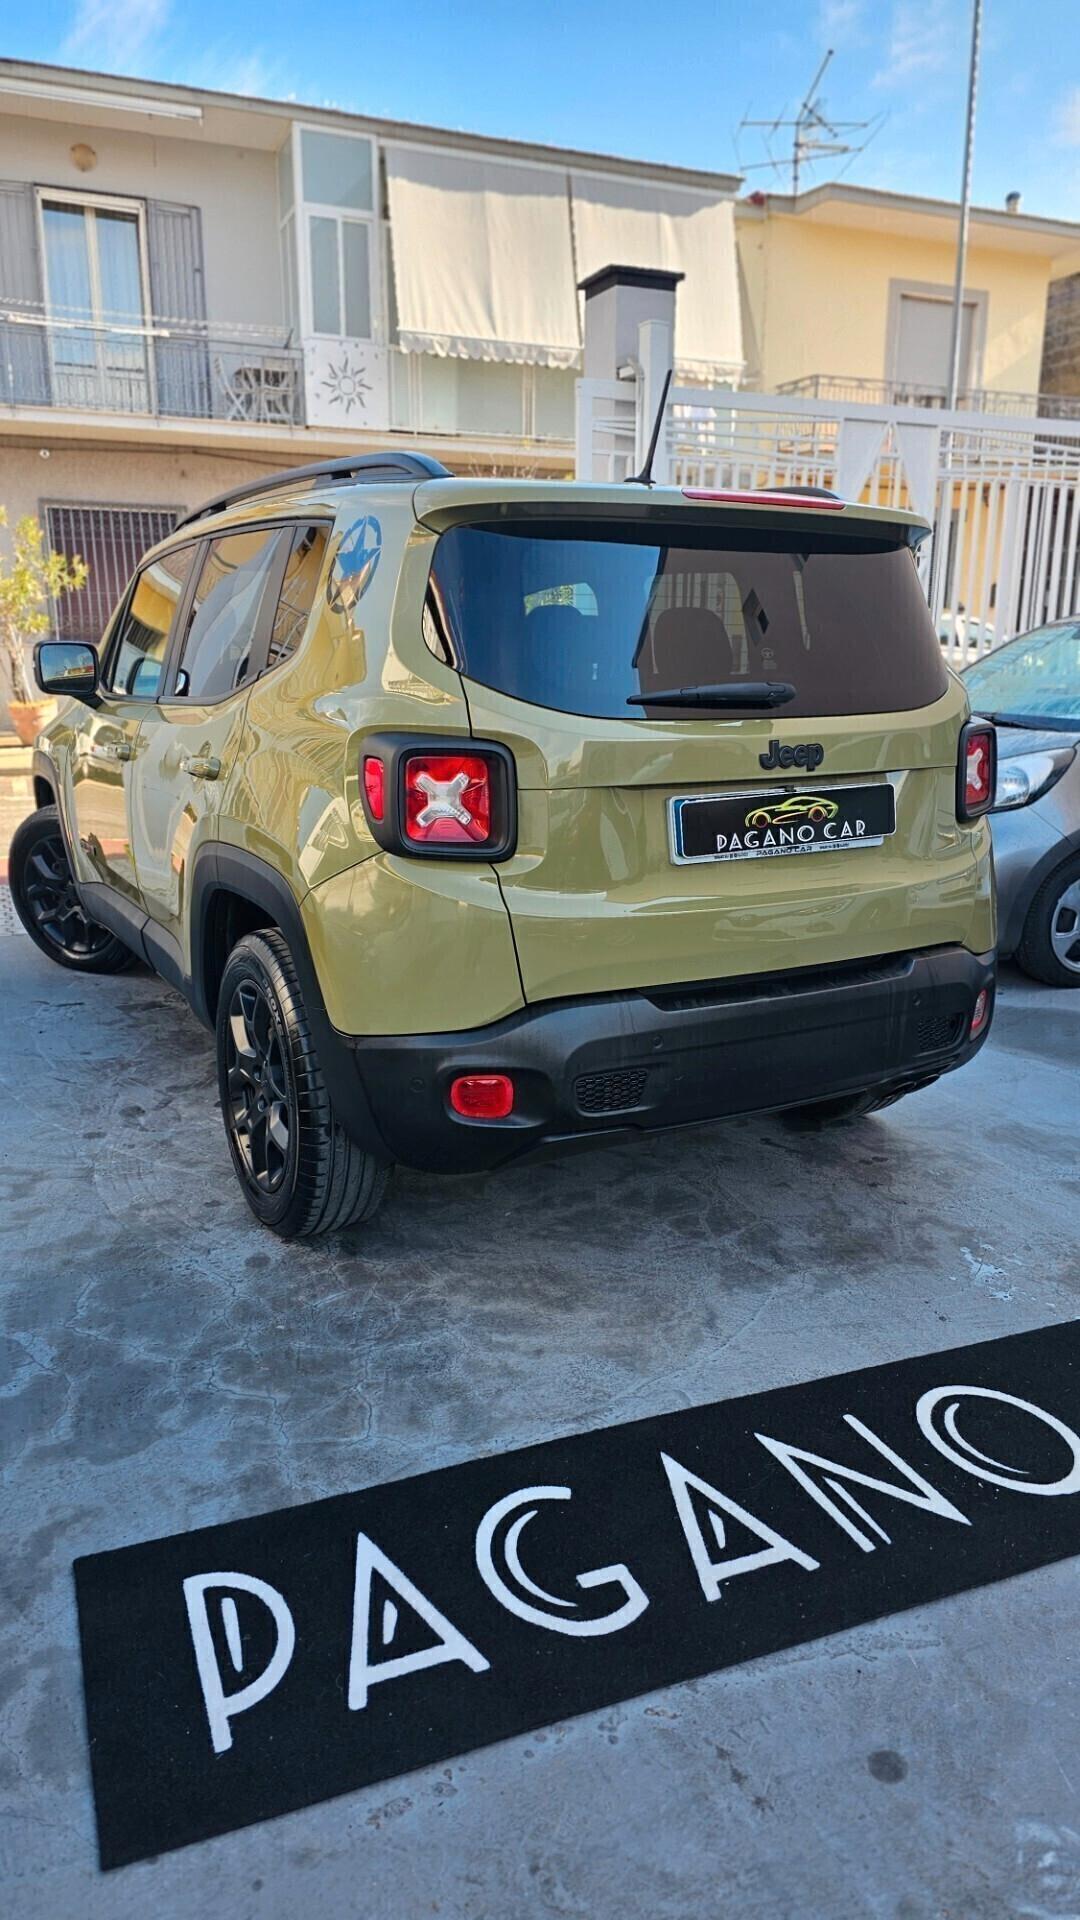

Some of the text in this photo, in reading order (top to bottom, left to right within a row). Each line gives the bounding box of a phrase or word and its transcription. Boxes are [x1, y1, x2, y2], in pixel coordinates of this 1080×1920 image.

[759, 739, 825, 772] Jeep
[716, 819, 867, 853] PAGANO CAR
[756, 846, 794, 857] PAGANO
[795, 845, 812, 854] CAR
[182, 1384, 1080, 1754] PAGANO
